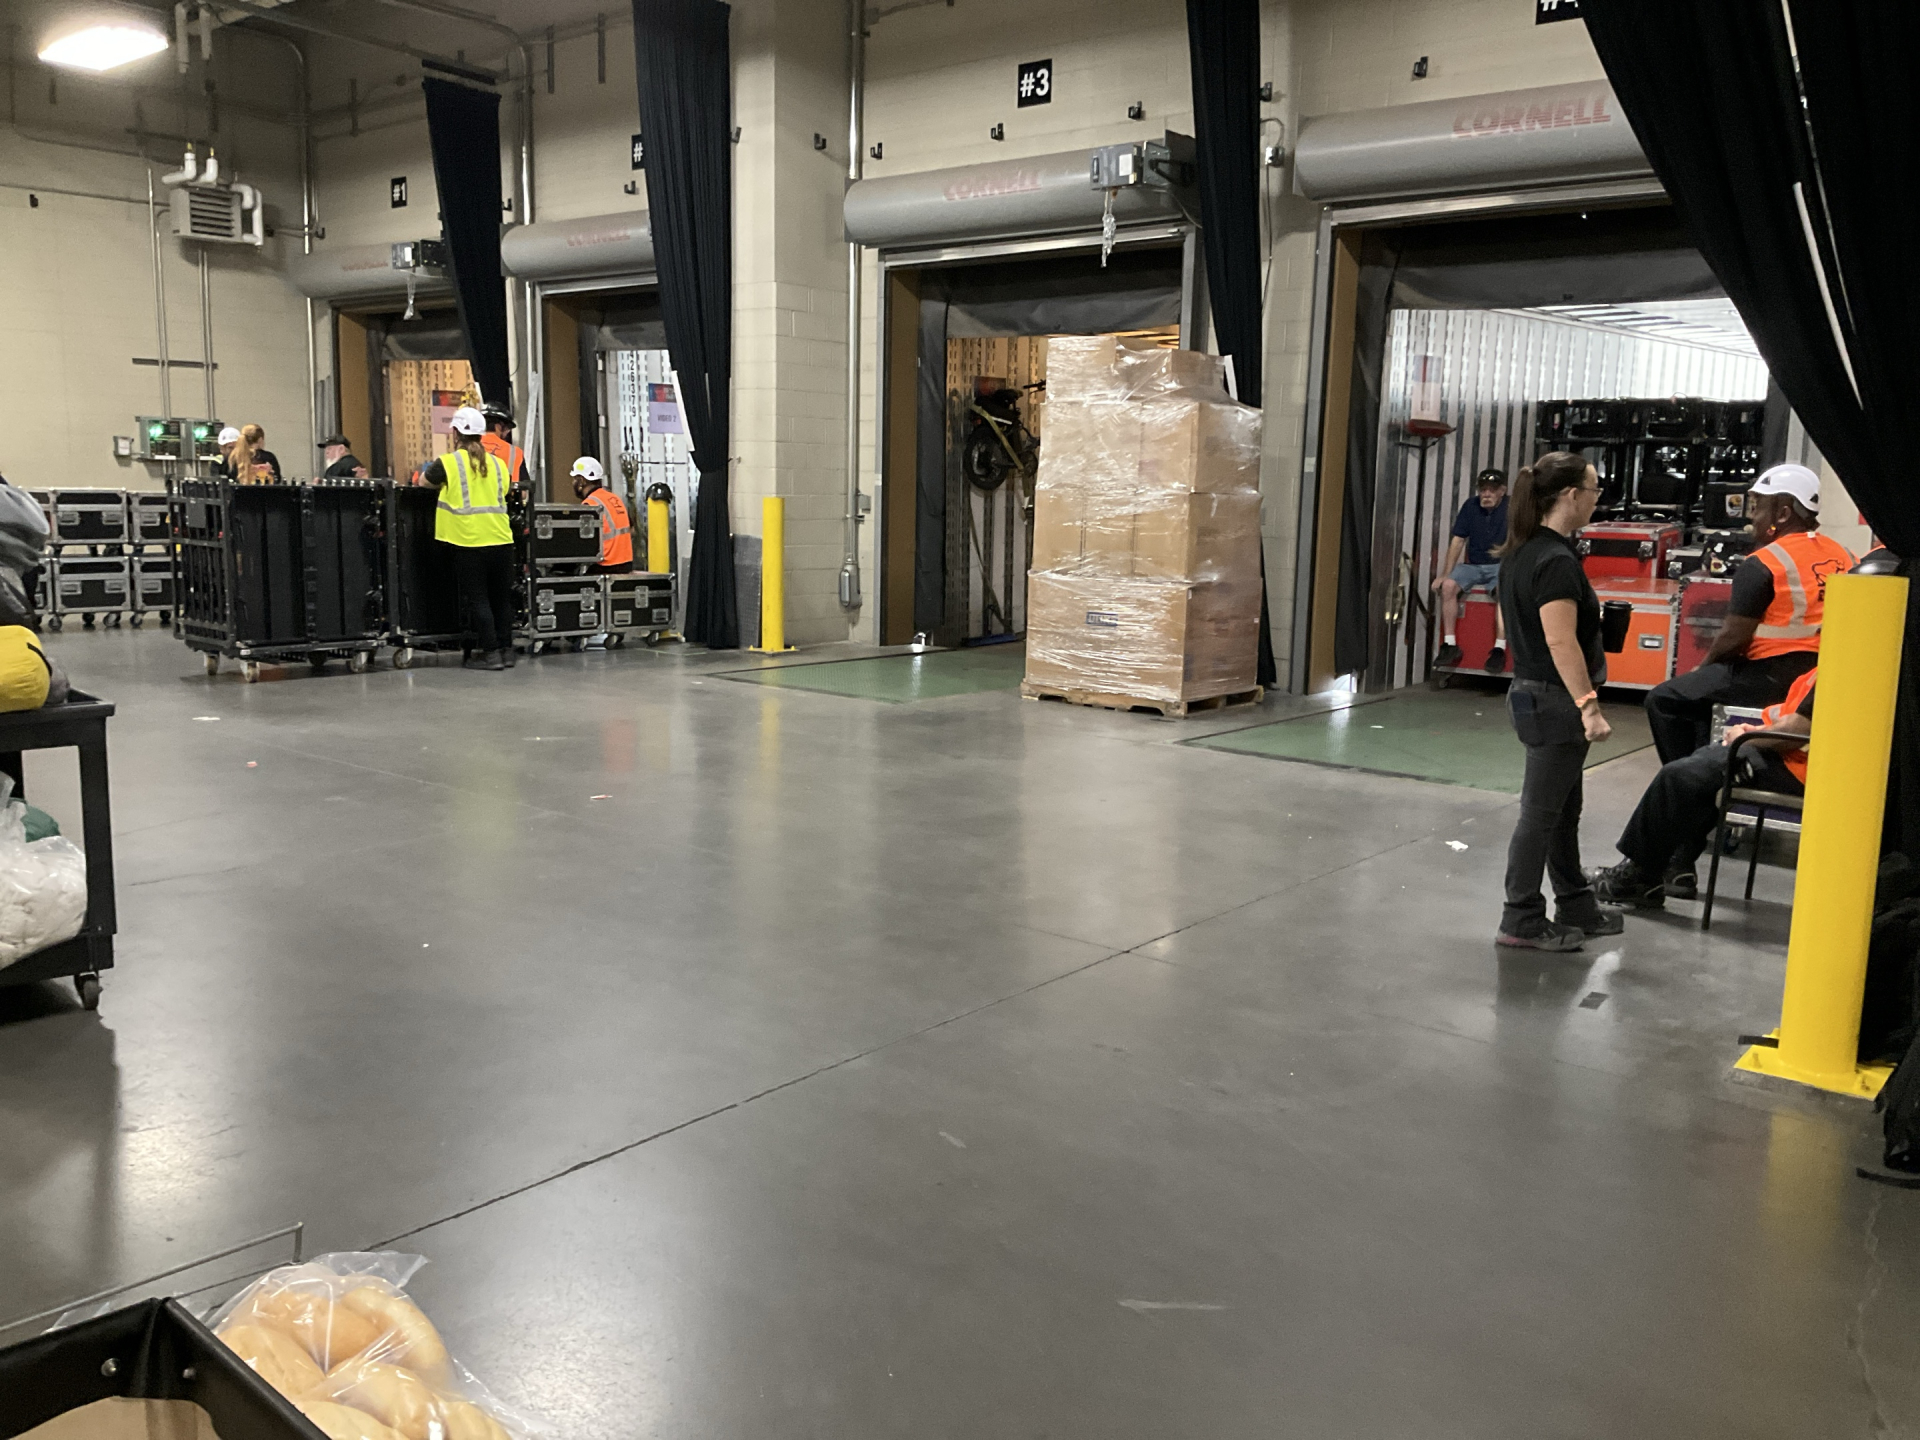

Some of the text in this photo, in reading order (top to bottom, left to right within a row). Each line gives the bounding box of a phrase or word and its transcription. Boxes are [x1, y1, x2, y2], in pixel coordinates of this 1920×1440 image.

[1020, 68, 1049, 98] #3
[1453, 93, 1611, 139] CORNELL
[392, 182, 406, 201] #1
